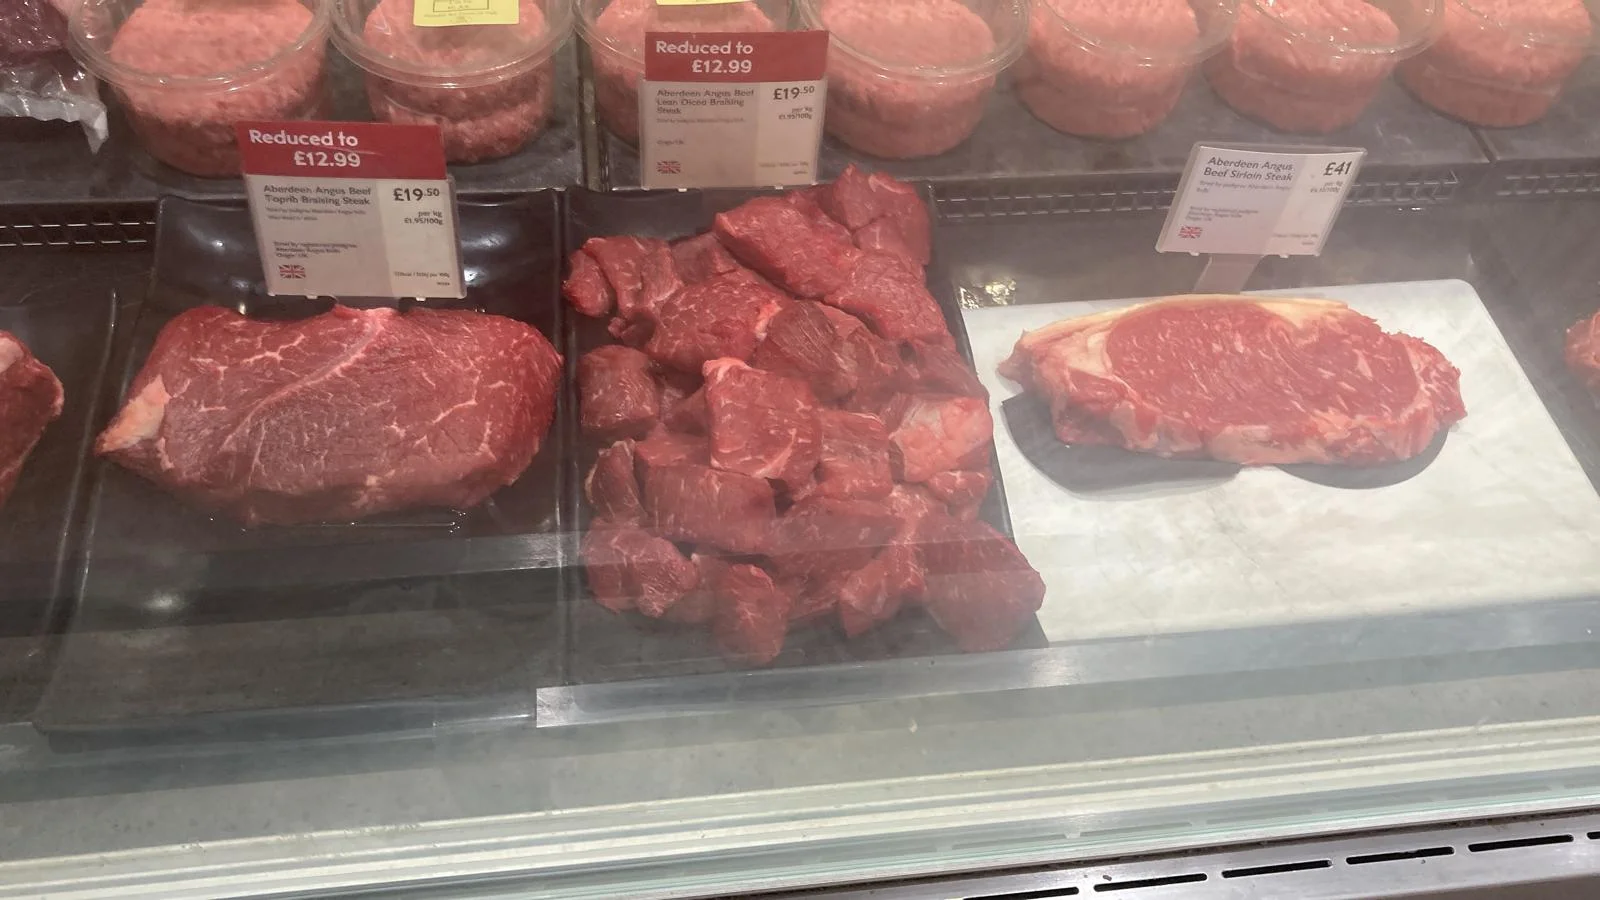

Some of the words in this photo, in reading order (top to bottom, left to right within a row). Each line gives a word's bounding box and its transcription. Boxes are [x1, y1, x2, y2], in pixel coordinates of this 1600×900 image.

[655, 40, 731, 54] Reduced
[736, 41, 753, 55] to
[692, 59, 752, 73] £12.99
[773, 85, 815, 100] £19.50
[249, 130, 333, 146] Reduced
[337, 131, 358, 147] to
[294, 151, 360, 168] £12.99
[1208, 157, 1259, 169] Aberdeen
[1261, 161, 1293, 172] Angus
[1203, 167, 1228, 177] Beef
[1229, 169, 1262, 180] Sirloin
[1264, 172, 1293, 181] Steak
[1323, 161, 1352, 176] £41
[264, 185, 312, 194] Aberdeen
[316, 186, 346, 196] Angus
[393, 188, 440, 201] £19.50
